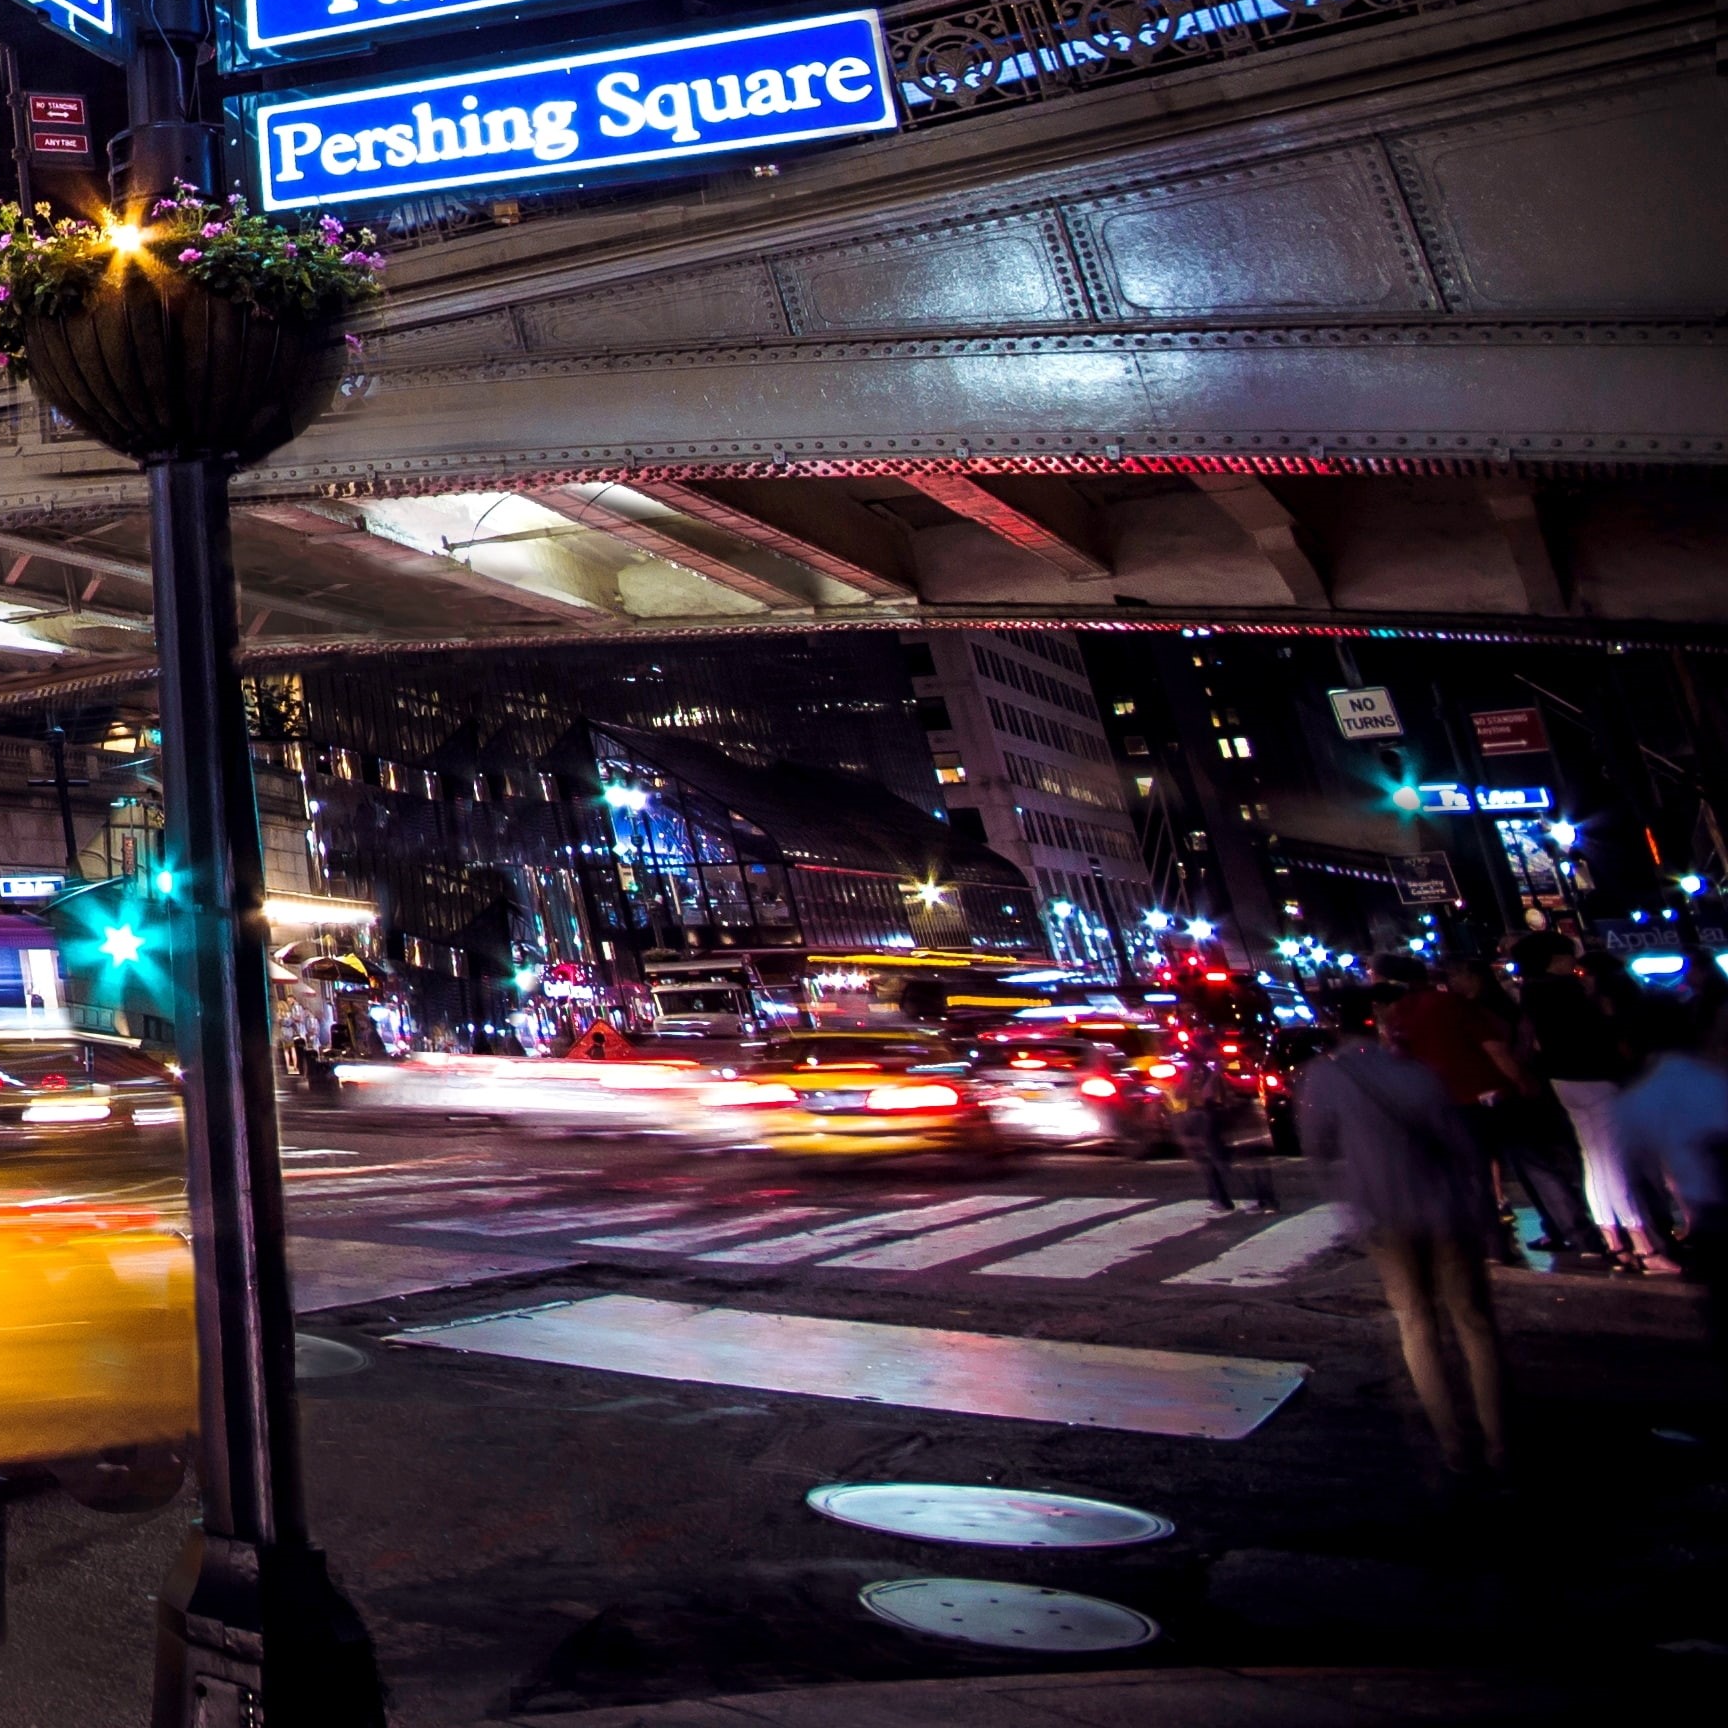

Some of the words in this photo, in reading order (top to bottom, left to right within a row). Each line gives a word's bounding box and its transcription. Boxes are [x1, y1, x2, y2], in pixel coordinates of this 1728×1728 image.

[35, 101, 46, 109] NO
[272, 94, 578, 183] Pershing
[596, 56, 874, 143] Square
[1349, 696, 1376, 713] NO
[1343, 713, 1396, 731] TURNS
[1607, 926, 1680, 953] Apple
